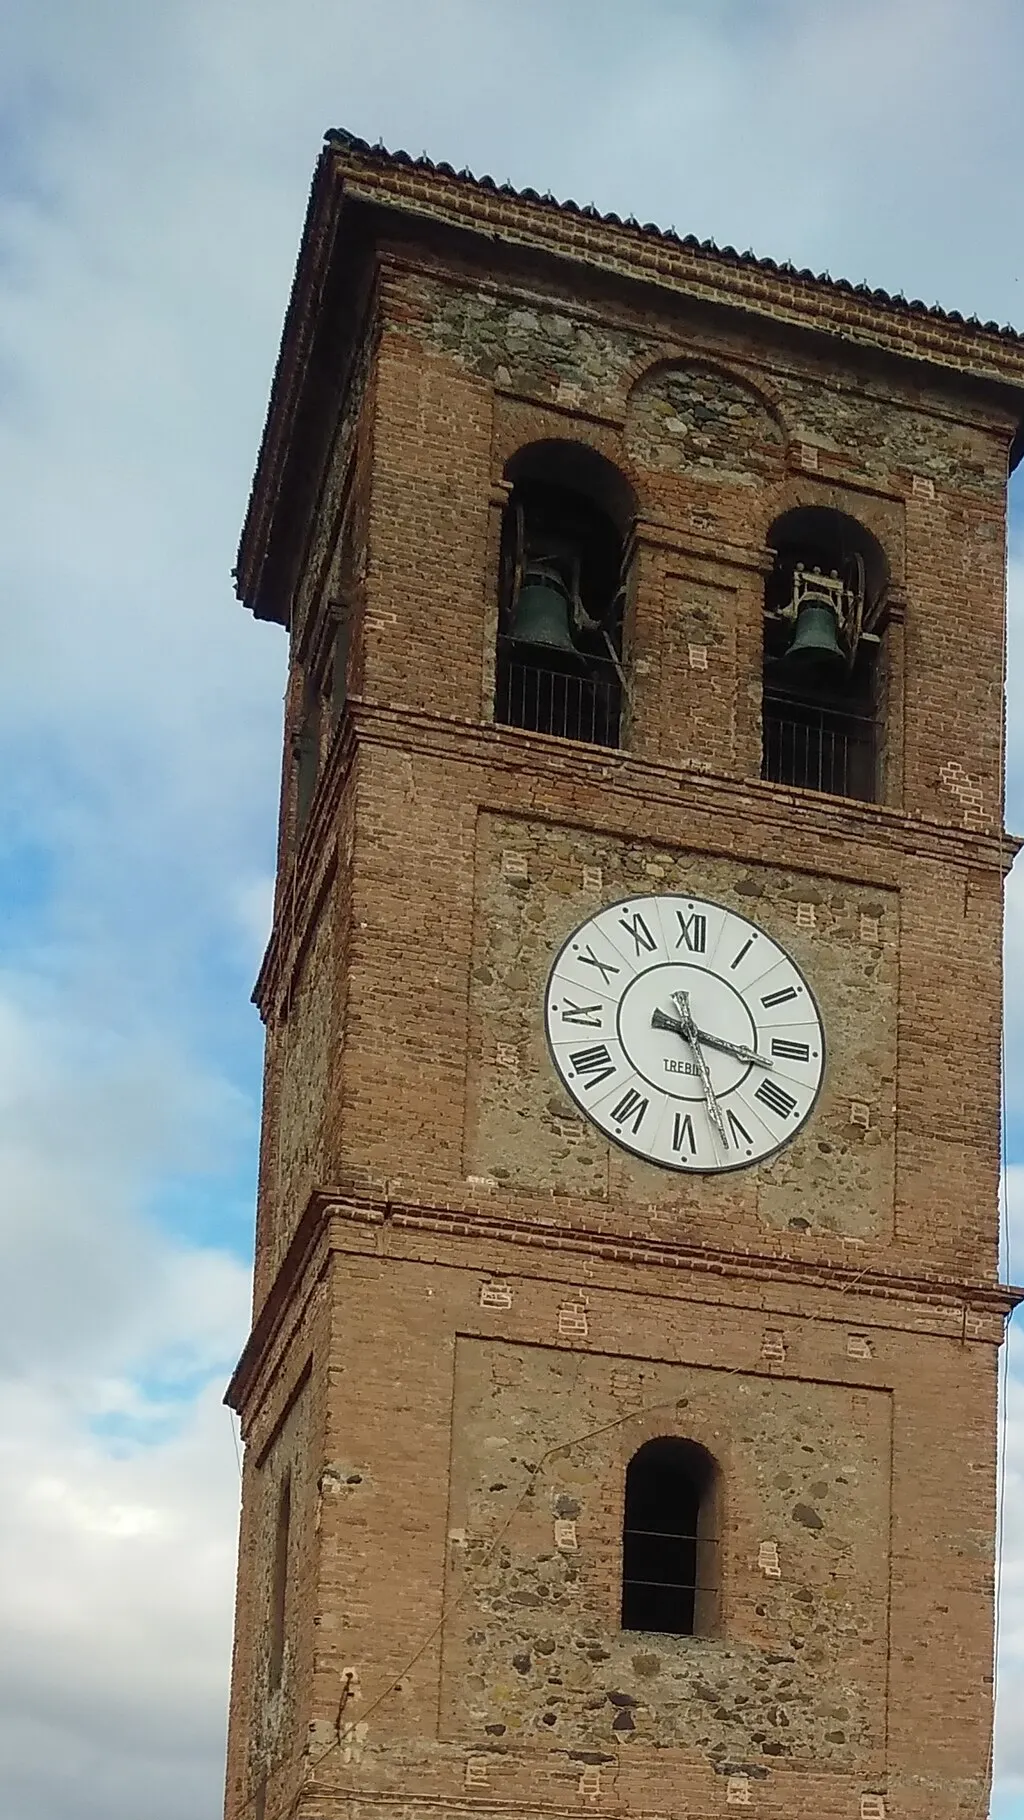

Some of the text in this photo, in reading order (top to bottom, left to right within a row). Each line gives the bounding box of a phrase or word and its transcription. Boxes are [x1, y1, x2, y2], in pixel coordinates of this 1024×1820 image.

[618, 913, 658, 957] XI
[675, 910, 706, 953] XII
[577, 945, 620, 985] X
[730, 939, 753, 970] I
[561, 997, 603, 1028] IX
[760, 986, 798, 1009] II
[568, 1044, 617, 1091] VIII
[771, 1037, 810, 1062] III
[609, 1087, 650, 1135] VII
[754, 1077, 798, 1120] IIII
[672, 1112, 697, 1155] VI
[725, 1109, 754, 1150] V
